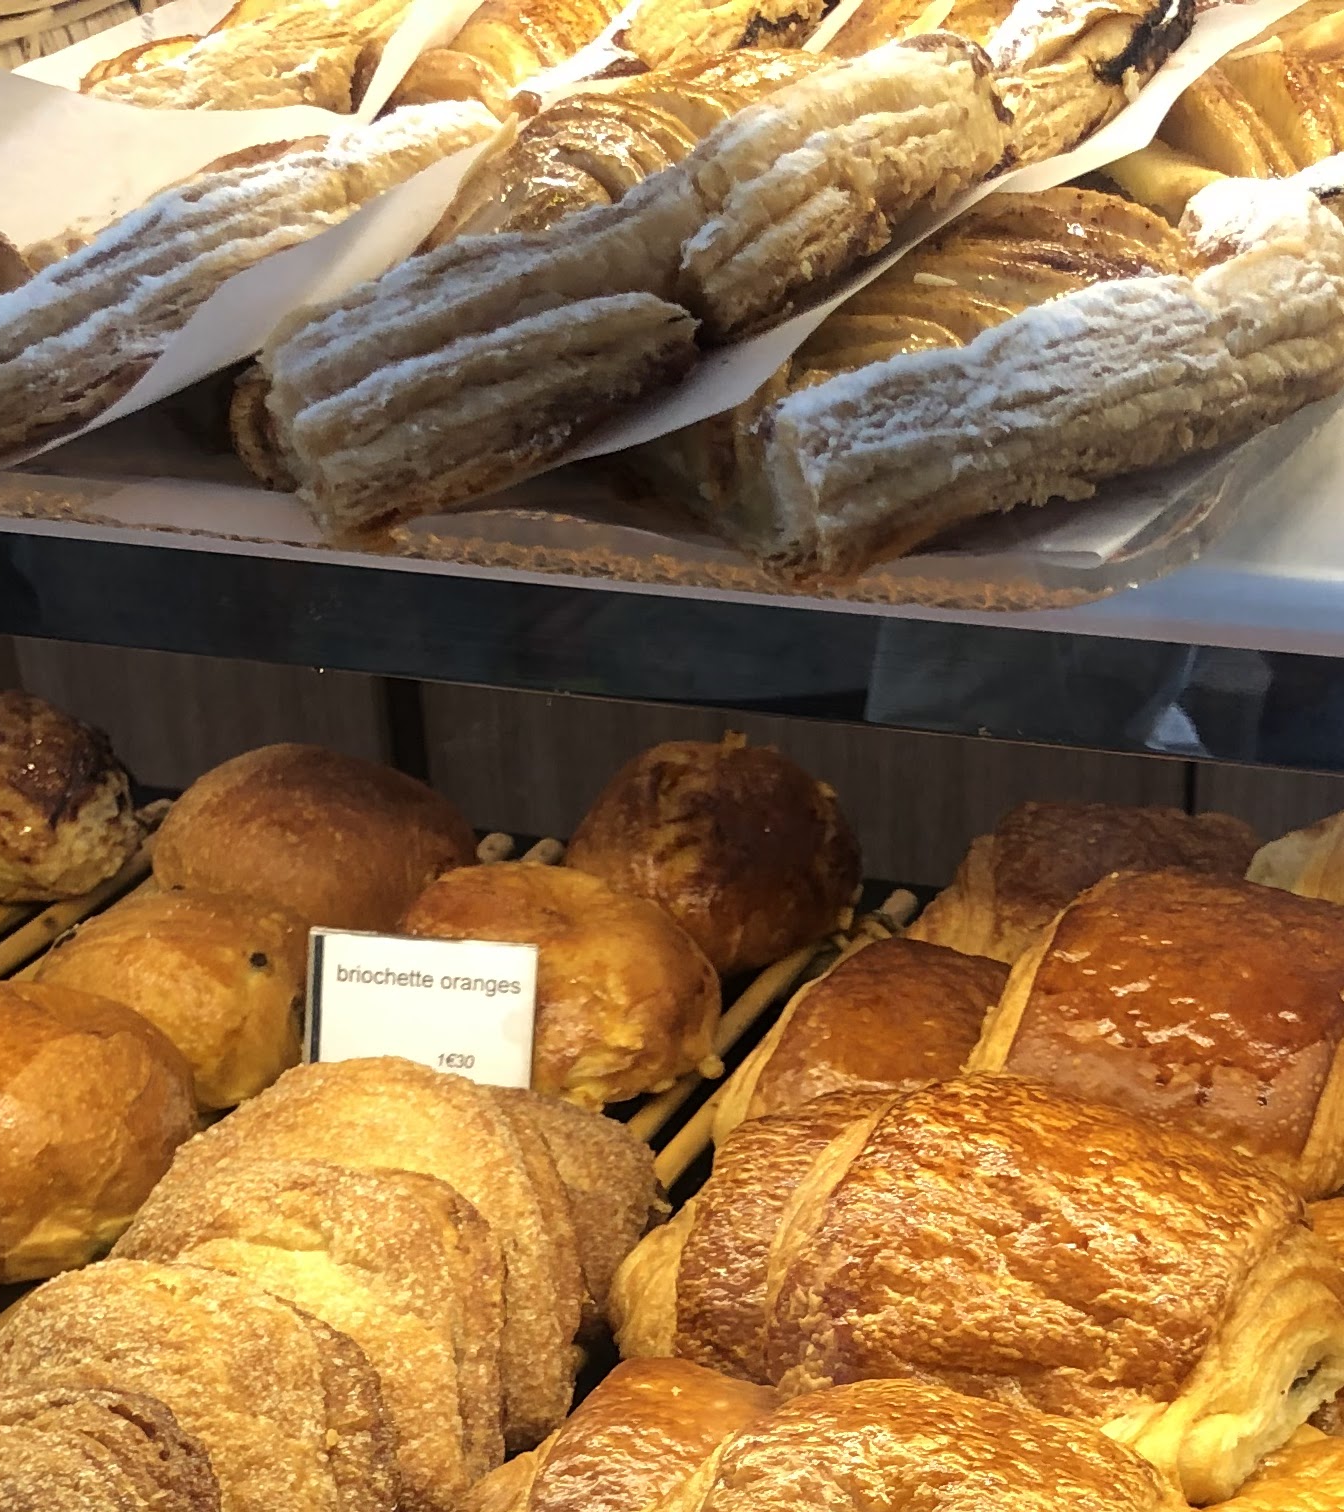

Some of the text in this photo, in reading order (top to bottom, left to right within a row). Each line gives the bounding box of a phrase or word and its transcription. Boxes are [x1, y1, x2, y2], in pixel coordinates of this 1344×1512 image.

[336, 964, 521, 997] briochette oranges
[438, 1053, 475, 1069] 1€30
